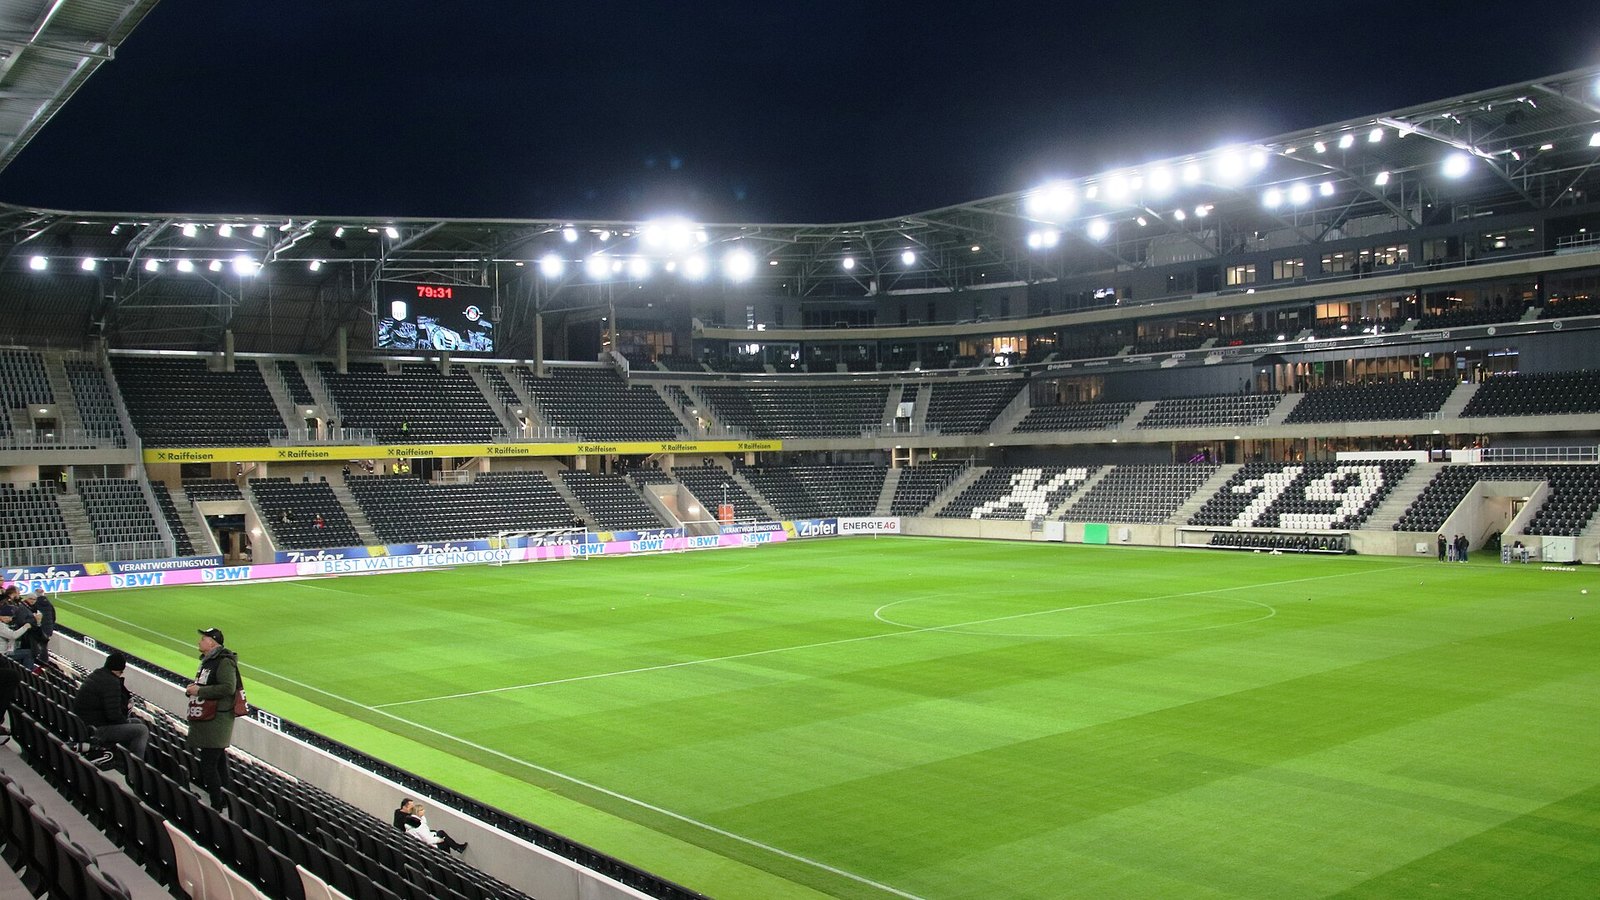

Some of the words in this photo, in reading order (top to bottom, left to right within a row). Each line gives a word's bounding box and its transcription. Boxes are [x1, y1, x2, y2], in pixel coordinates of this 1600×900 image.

[416, 286, 453, 298] 79:31
[494, 446, 529, 454] Raiffeisen
[667, 443, 697, 451] Raiffeisen
[744, 442, 771, 450] Raiffeisen
[168, 452, 213, 460] Raiffeisen
[287, 450, 329, 458] Raiffeisen
[396, 448, 434, 456] Raiffeisen
[1232, 466, 1381, 529] 19
[801, 521, 836, 536] Zipfer
[884, 521, 896, 529] AG
[697, 536, 719, 547] BWT
[750, 533, 770, 543] BWT
[580, 544, 605, 554] BWT
[640, 540, 663, 550] BWT
[118, 559, 219, 571] VERANTWORTUNGSVOLL
[325, 559, 360, 572] BEST
[365, 557, 414, 569] WATER
[418, 550, 512, 565] TECHNOLOGY
[216, 567, 250, 580] BWT
[126, 573, 163, 586] BWT
[30, 579, 71, 593] BWT
